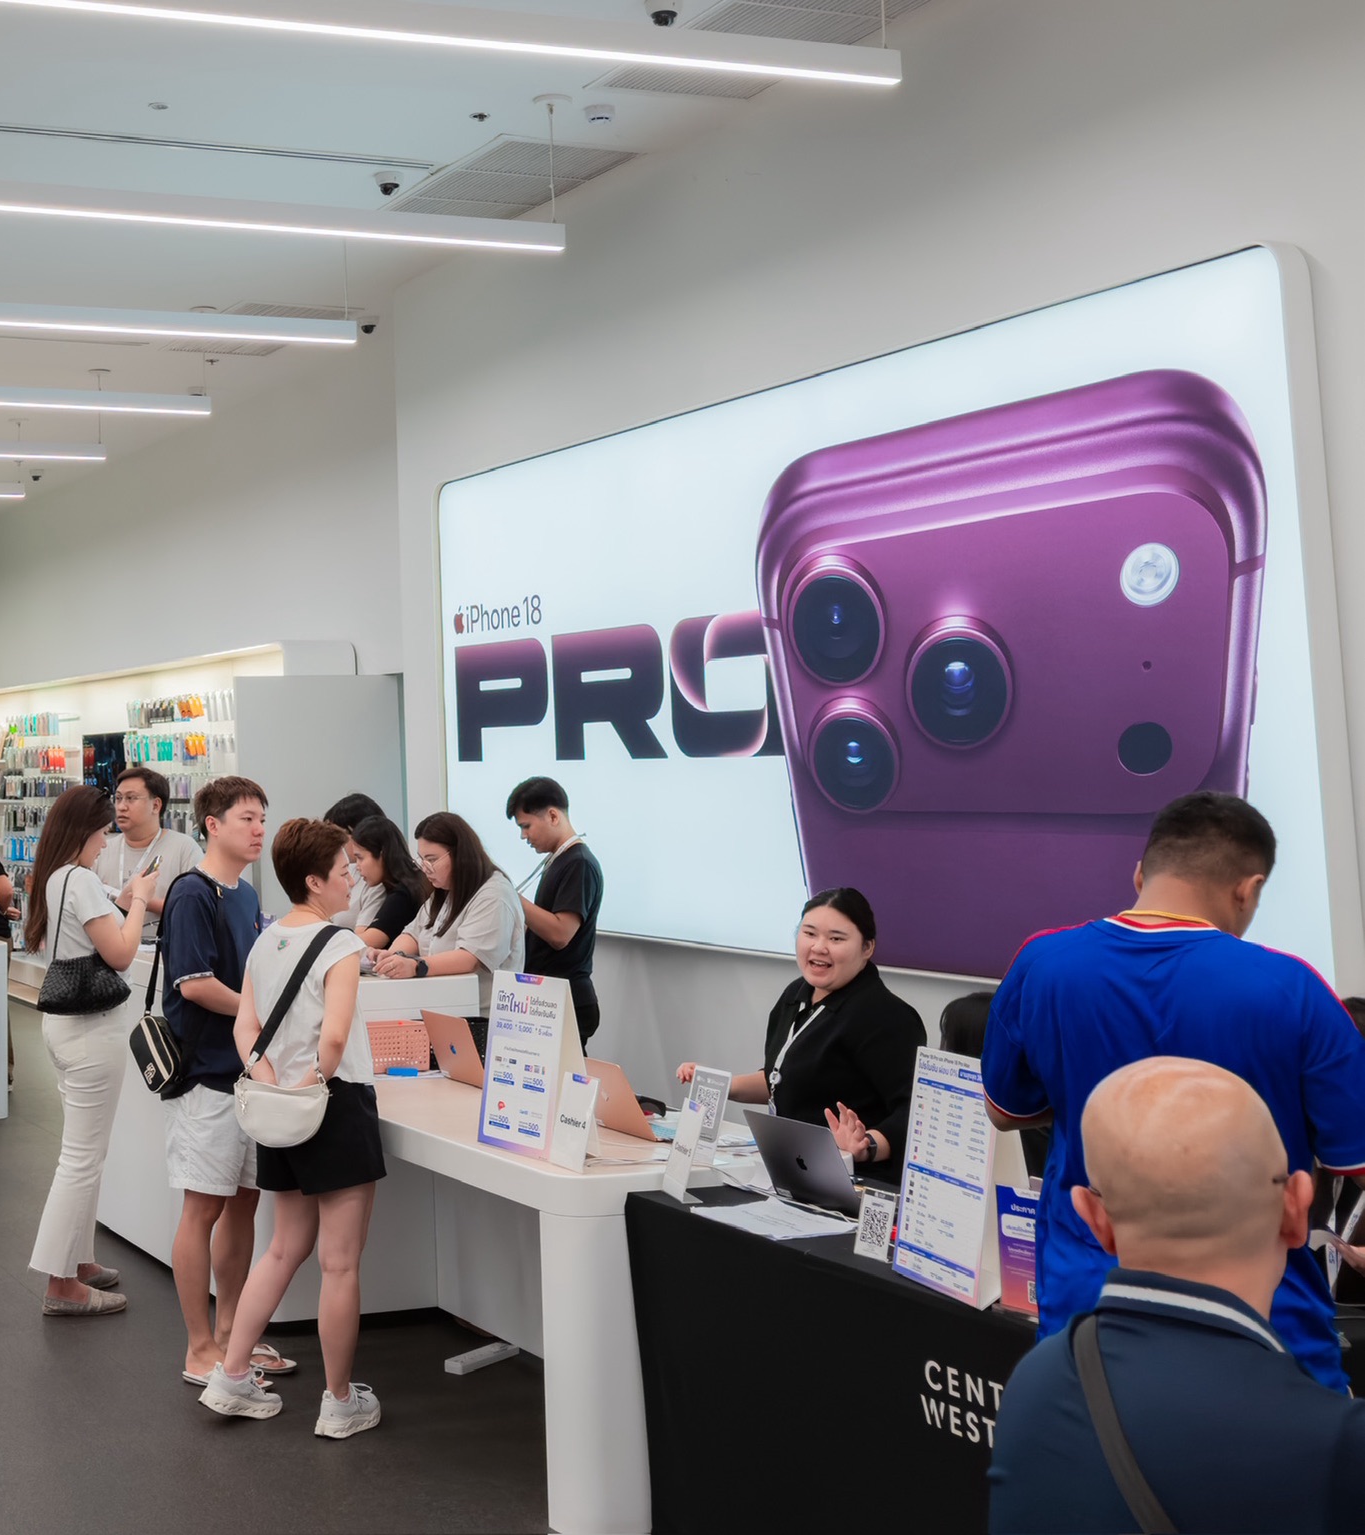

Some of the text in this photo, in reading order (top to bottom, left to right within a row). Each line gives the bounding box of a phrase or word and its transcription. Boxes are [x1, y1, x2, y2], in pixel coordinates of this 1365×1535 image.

[465, 594, 542, 634] iPhone 18
[454, 608, 786, 762] PRO
[509, 993, 529, 1014] ใหม่
[503, 1070, 513, 1080] 500
[533, 1077, 543, 1087] 500
[498, 1114, 509, 1124] 500
[528, 1122, 539, 1132] 500
[559, 1113, 587, 1130] Cashier 4
[674, 1141, 689, 1156] Cashier
[924, 1359, 1004, 1412] CENT
[919, 1393, 996, 1449] WEST
